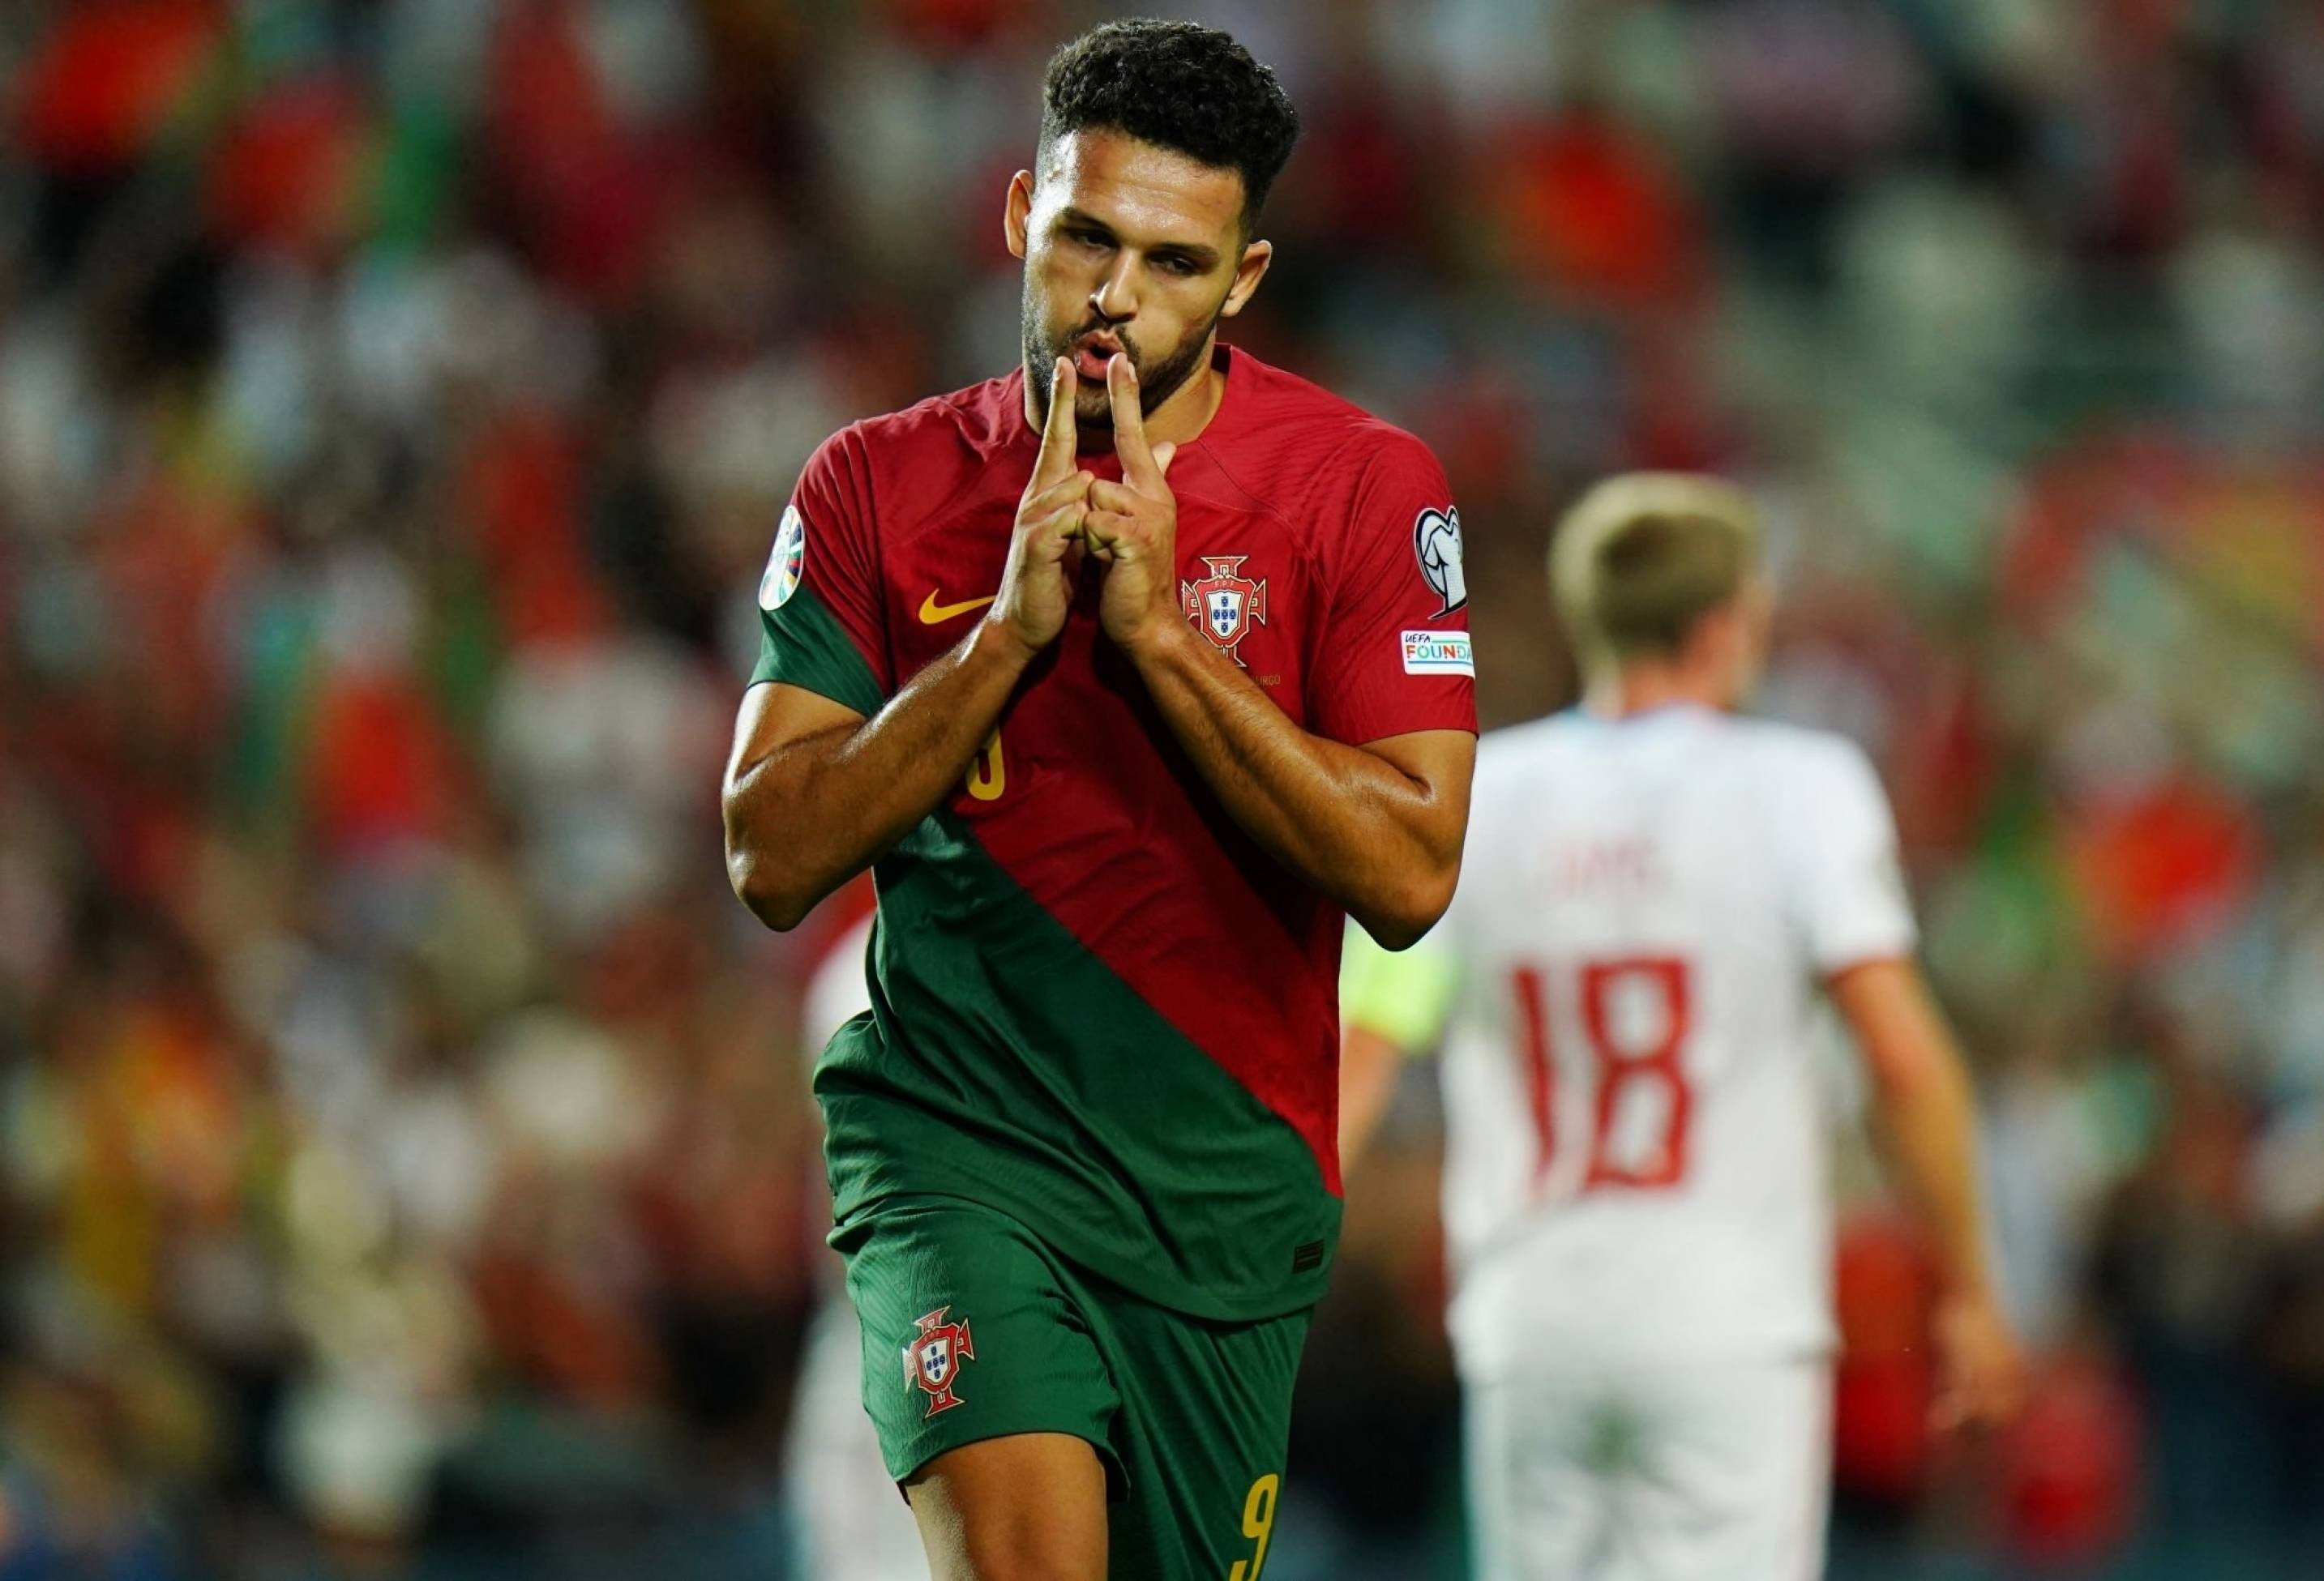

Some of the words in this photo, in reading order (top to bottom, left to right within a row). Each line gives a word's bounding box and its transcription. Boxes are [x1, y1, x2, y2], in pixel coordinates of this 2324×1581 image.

[1406, 634, 1431, 643] UEFA
[1513, 953, 1691, 1194] 18
[1230, 1473, 1278, 1581] 9
